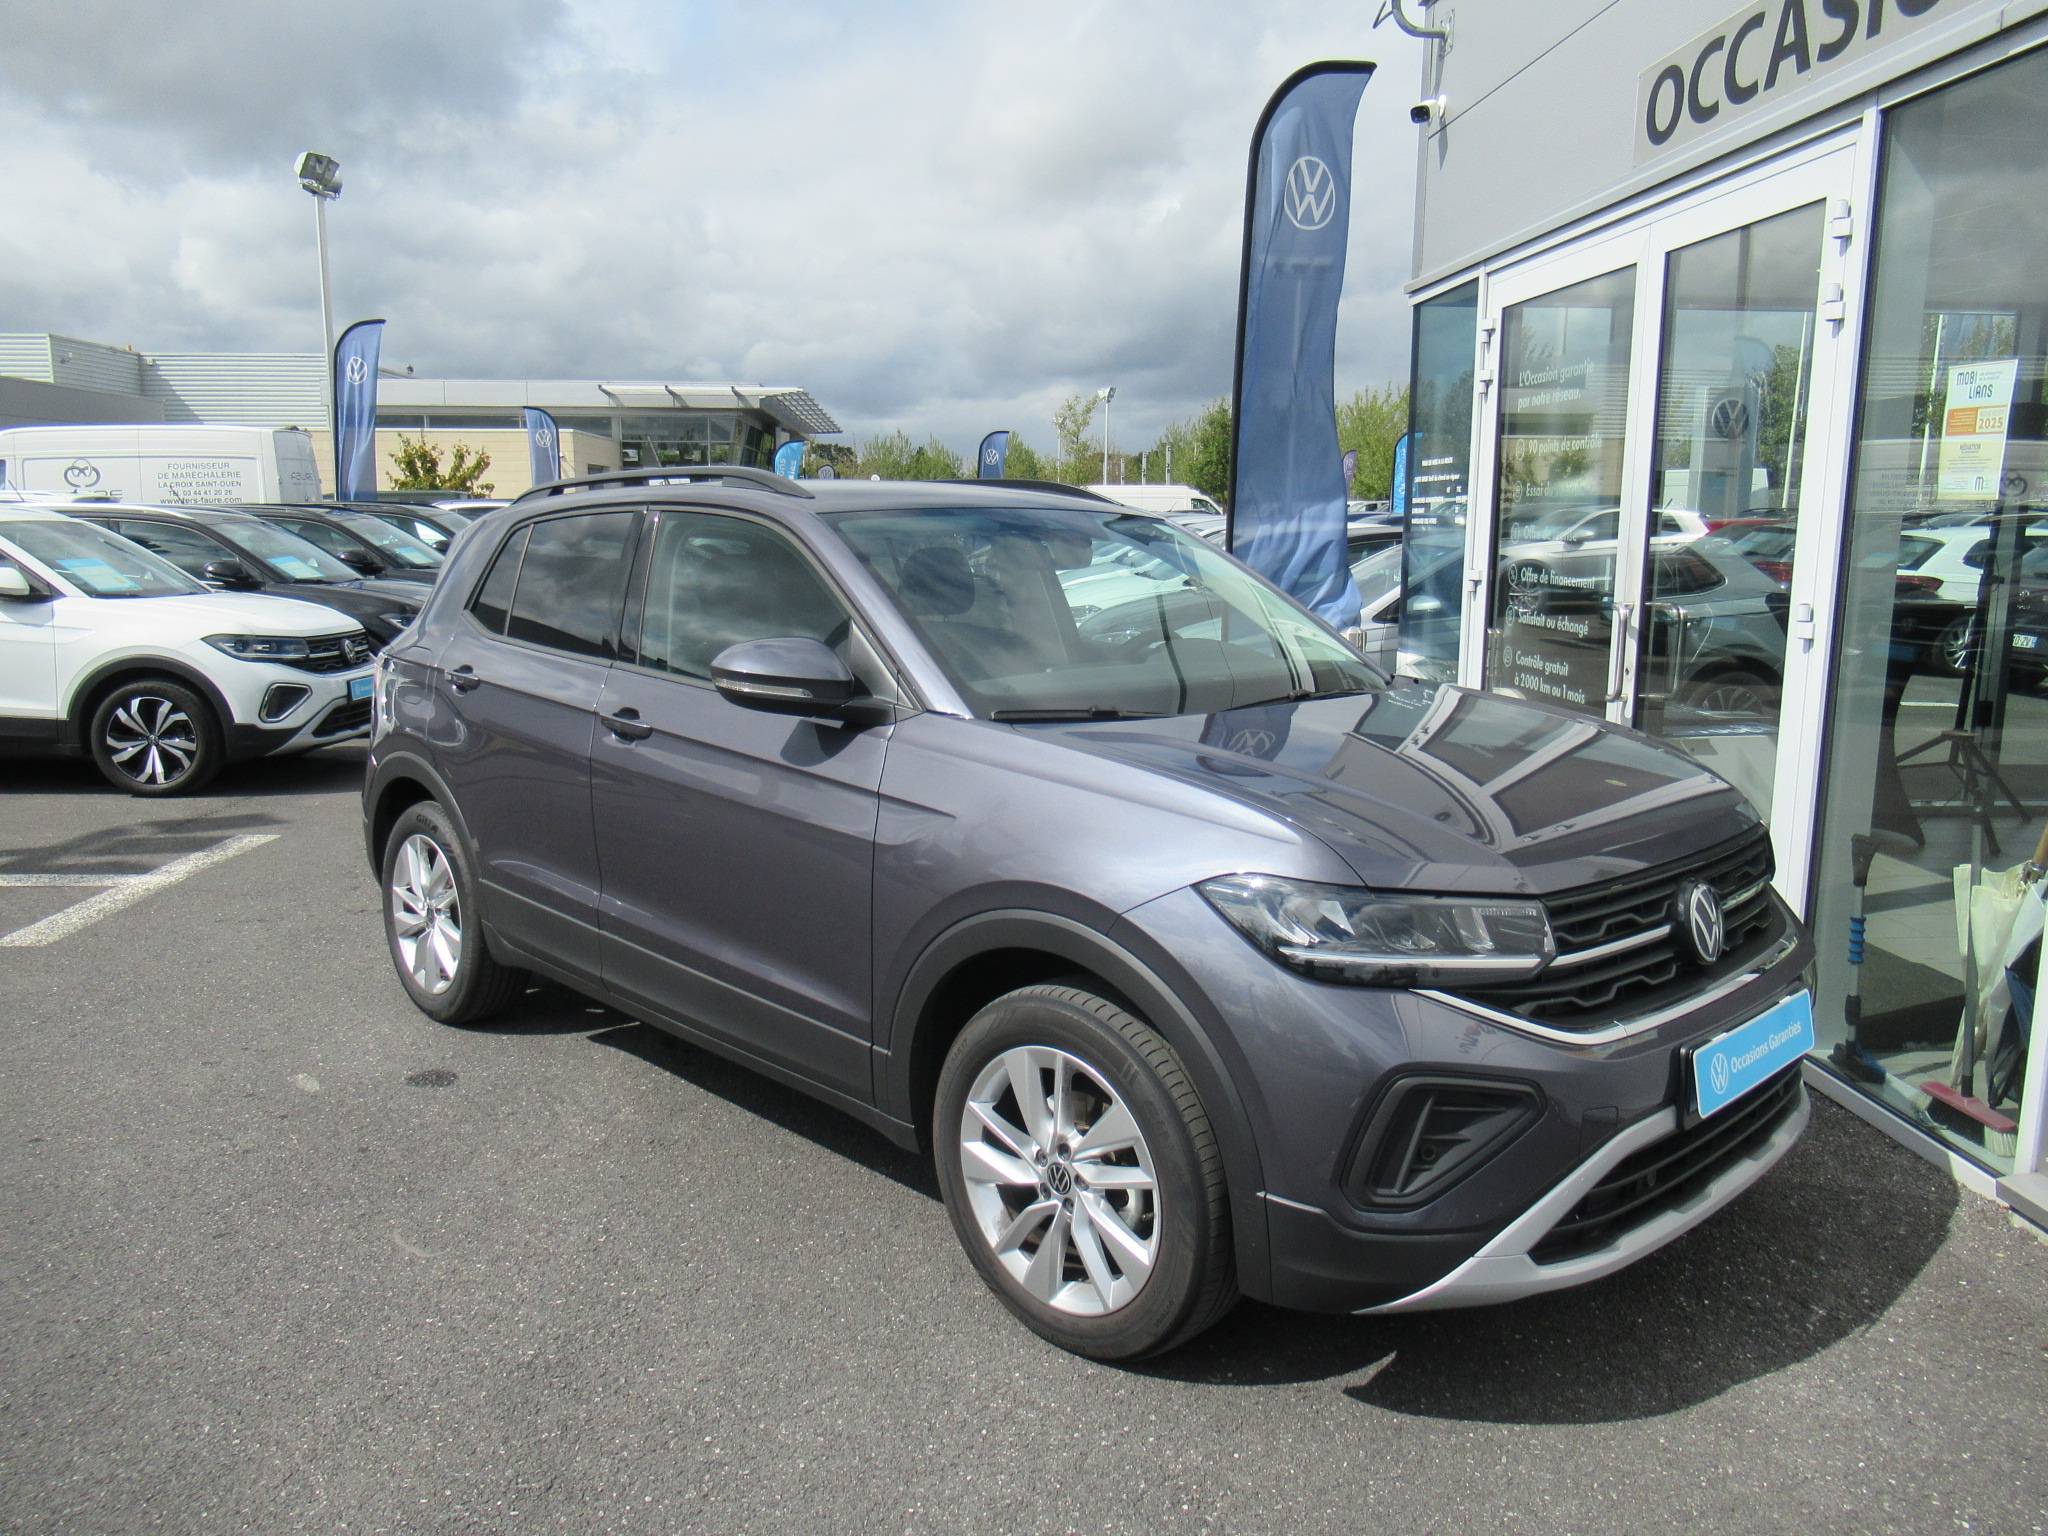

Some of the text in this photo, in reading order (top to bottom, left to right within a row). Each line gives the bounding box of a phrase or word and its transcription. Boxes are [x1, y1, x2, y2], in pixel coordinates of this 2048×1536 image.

[1646, 0, 1942, 146] OCCAS
[1519, 366, 1558, 387] L'Occasion
[1517, 397, 1530, 413] par
[1531, 391, 1552, 407] notre
[1979, 416, 2004, 430] 2025
[1528, 431, 1602, 456] 90 points de contrôle
[157, 472, 169, 480] DE
[167, 462, 230, 470] FOURNISSEUR
[157, 480, 242, 489] LA CROIX SAINT-OUEN
[1525, 482, 1543, 497] Essai
[1520, 566, 1596, 590] Offre de financement
[1518, 609, 1589, 638] Satisfait ou échangé
[1515, 650, 1569, 677] Contrôle gratuit
[1514, 672, 1519, 685] à
[1540, 676, 1551, 694] km
[1551, 685, 1561, 697] ou
[1562, 684, 1567, 699] 1
[1567, 689, 1585, 705] mois
[1730, 1040, 1769, 1073] Occasions
[1768, 1020, 1803, 1051] Garanties
